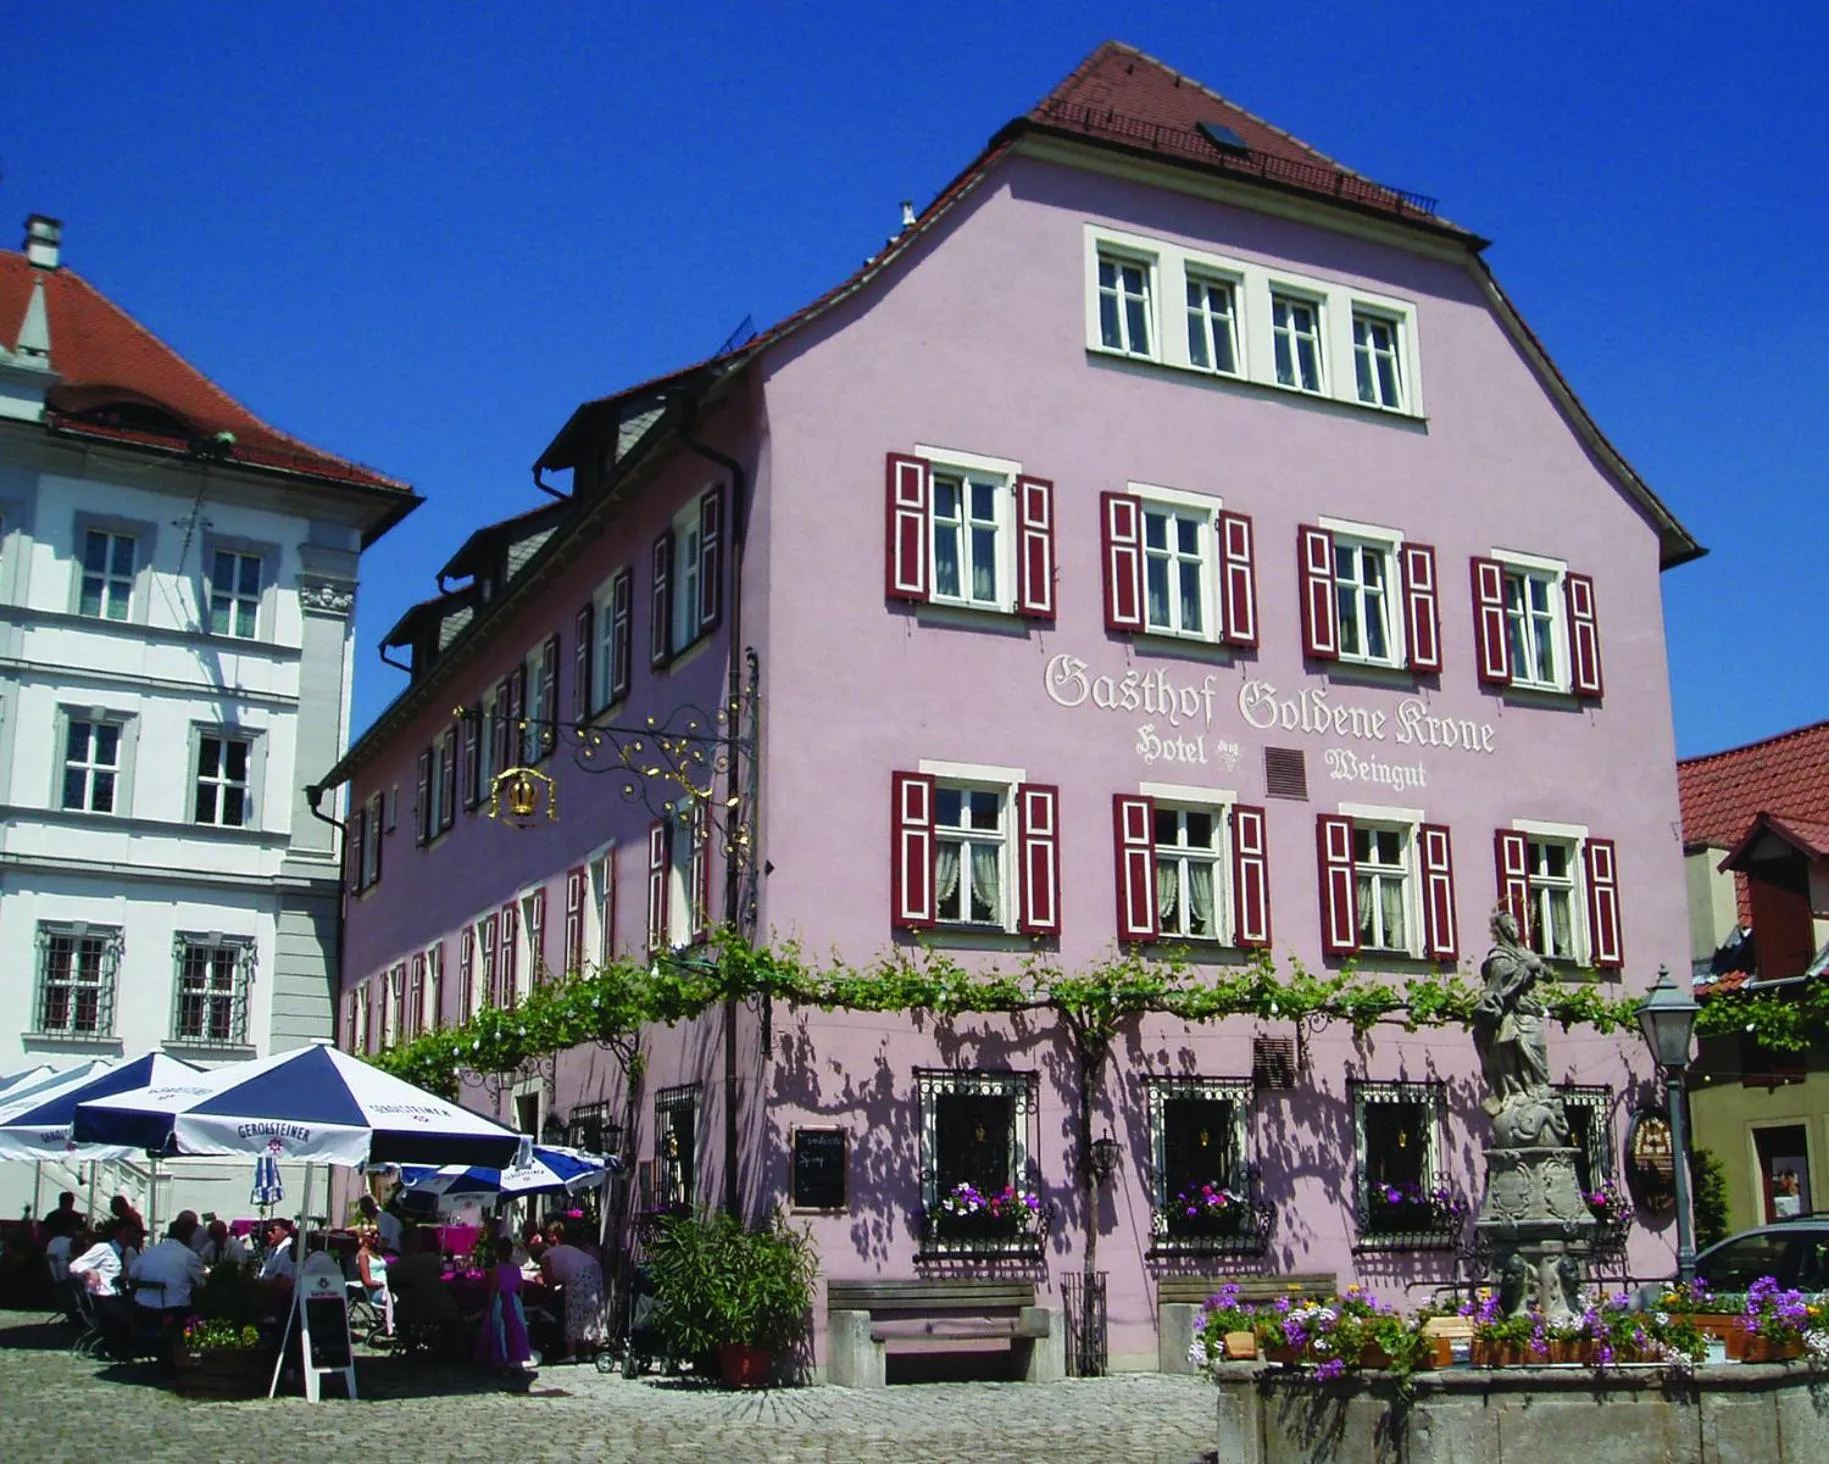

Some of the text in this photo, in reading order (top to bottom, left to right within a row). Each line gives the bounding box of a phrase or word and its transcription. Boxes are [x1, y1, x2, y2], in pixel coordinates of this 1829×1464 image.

[1044, 653, 1494, 753] Gasthof Goldene Krone
[1136, 723, 1427, 791] Hotel Weingut
[237, 1122, 312, 1142] GEROLSTEINER
